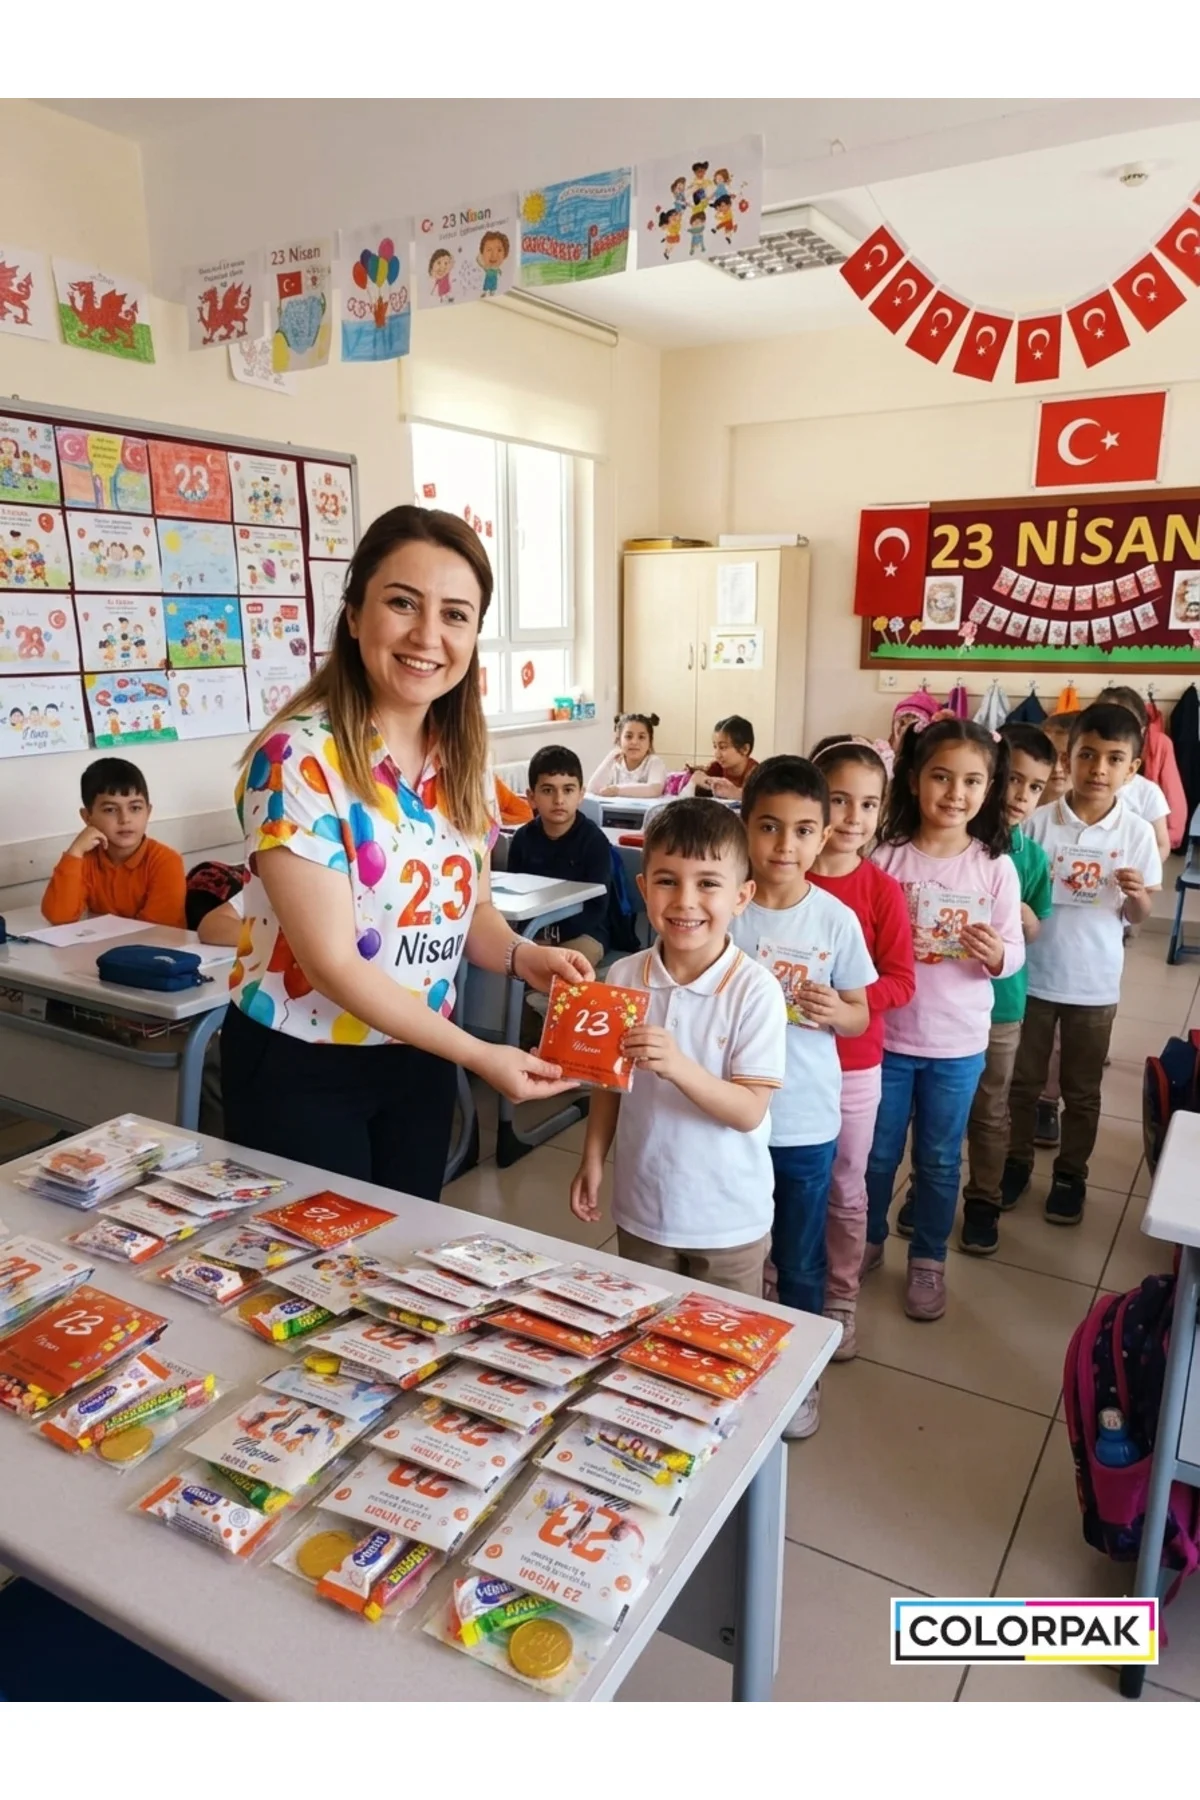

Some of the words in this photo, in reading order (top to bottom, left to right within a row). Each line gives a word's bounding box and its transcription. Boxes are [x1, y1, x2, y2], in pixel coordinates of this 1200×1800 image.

[442, 214, 456, 229] 23
[271, 251, 285, 266] 23
[931, 523, 993, 569] 23
[1016, 507, 1200, 566] NİSAN
[397, 854, 473, 928] 23
[574, 1009, 610, 1036] 23
[53, 1310, 104, 1335] 23
[538, 1499, 622, 1563] 23
